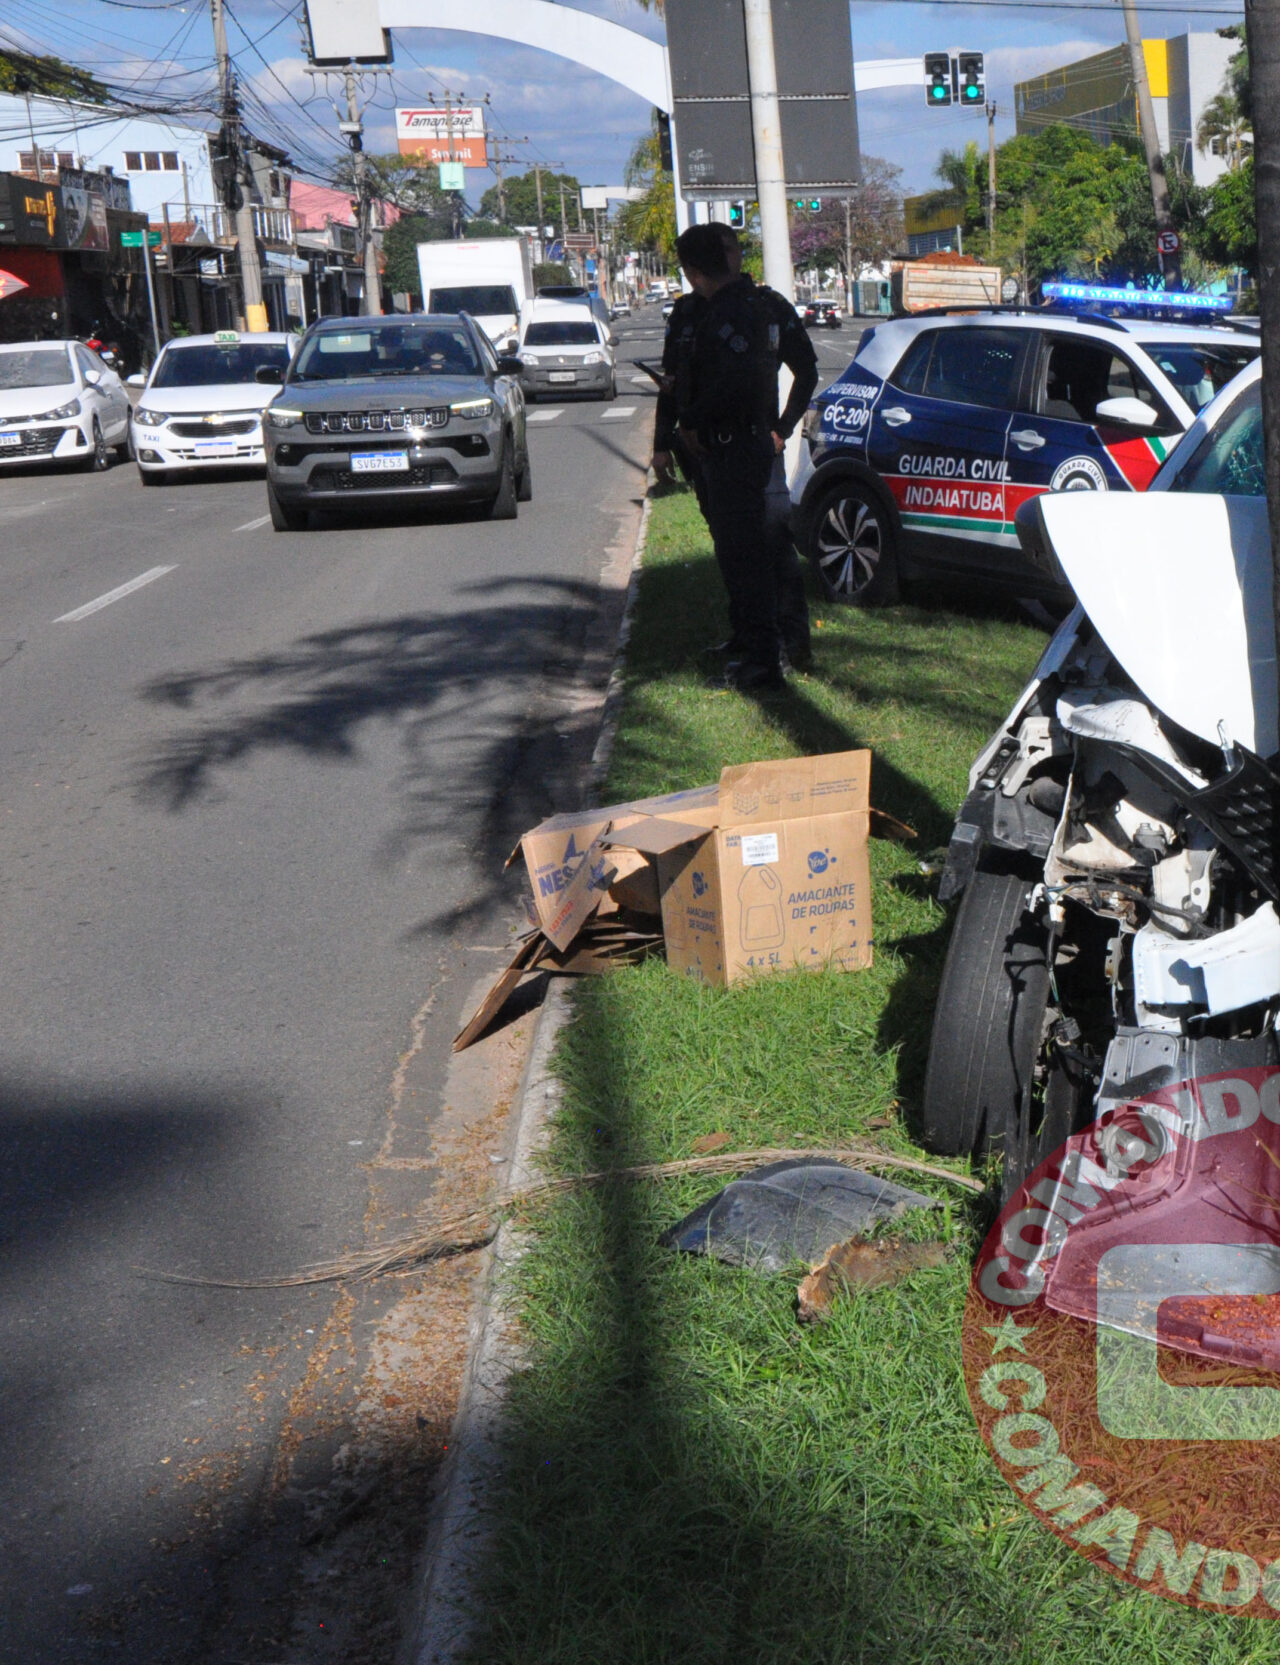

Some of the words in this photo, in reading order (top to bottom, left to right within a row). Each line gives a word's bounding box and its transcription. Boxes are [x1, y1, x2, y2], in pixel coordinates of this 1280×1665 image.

[217, 333, 236, 341] TAXI
[828, 383, 878, 399] SUPERVISOR
[824, 405, 870, 425] GC-200
[143, 434, 160, 442] TAXI
[899, 454, 966, 477] GUARDA
[970, 459, 1012, 481] CIVIL
[1059, 461, 1086, 479] GUARDA
[905, 485, 1005, 512] INDAIATUBA
[788, 883, 855, 904] AMACIANTE
[791, 906, 807, 919] DE
[808, 898, 855, 917] ROUPAS
[746, 956, 754, 966] 4
[768, 952, 781, 965] 5L
